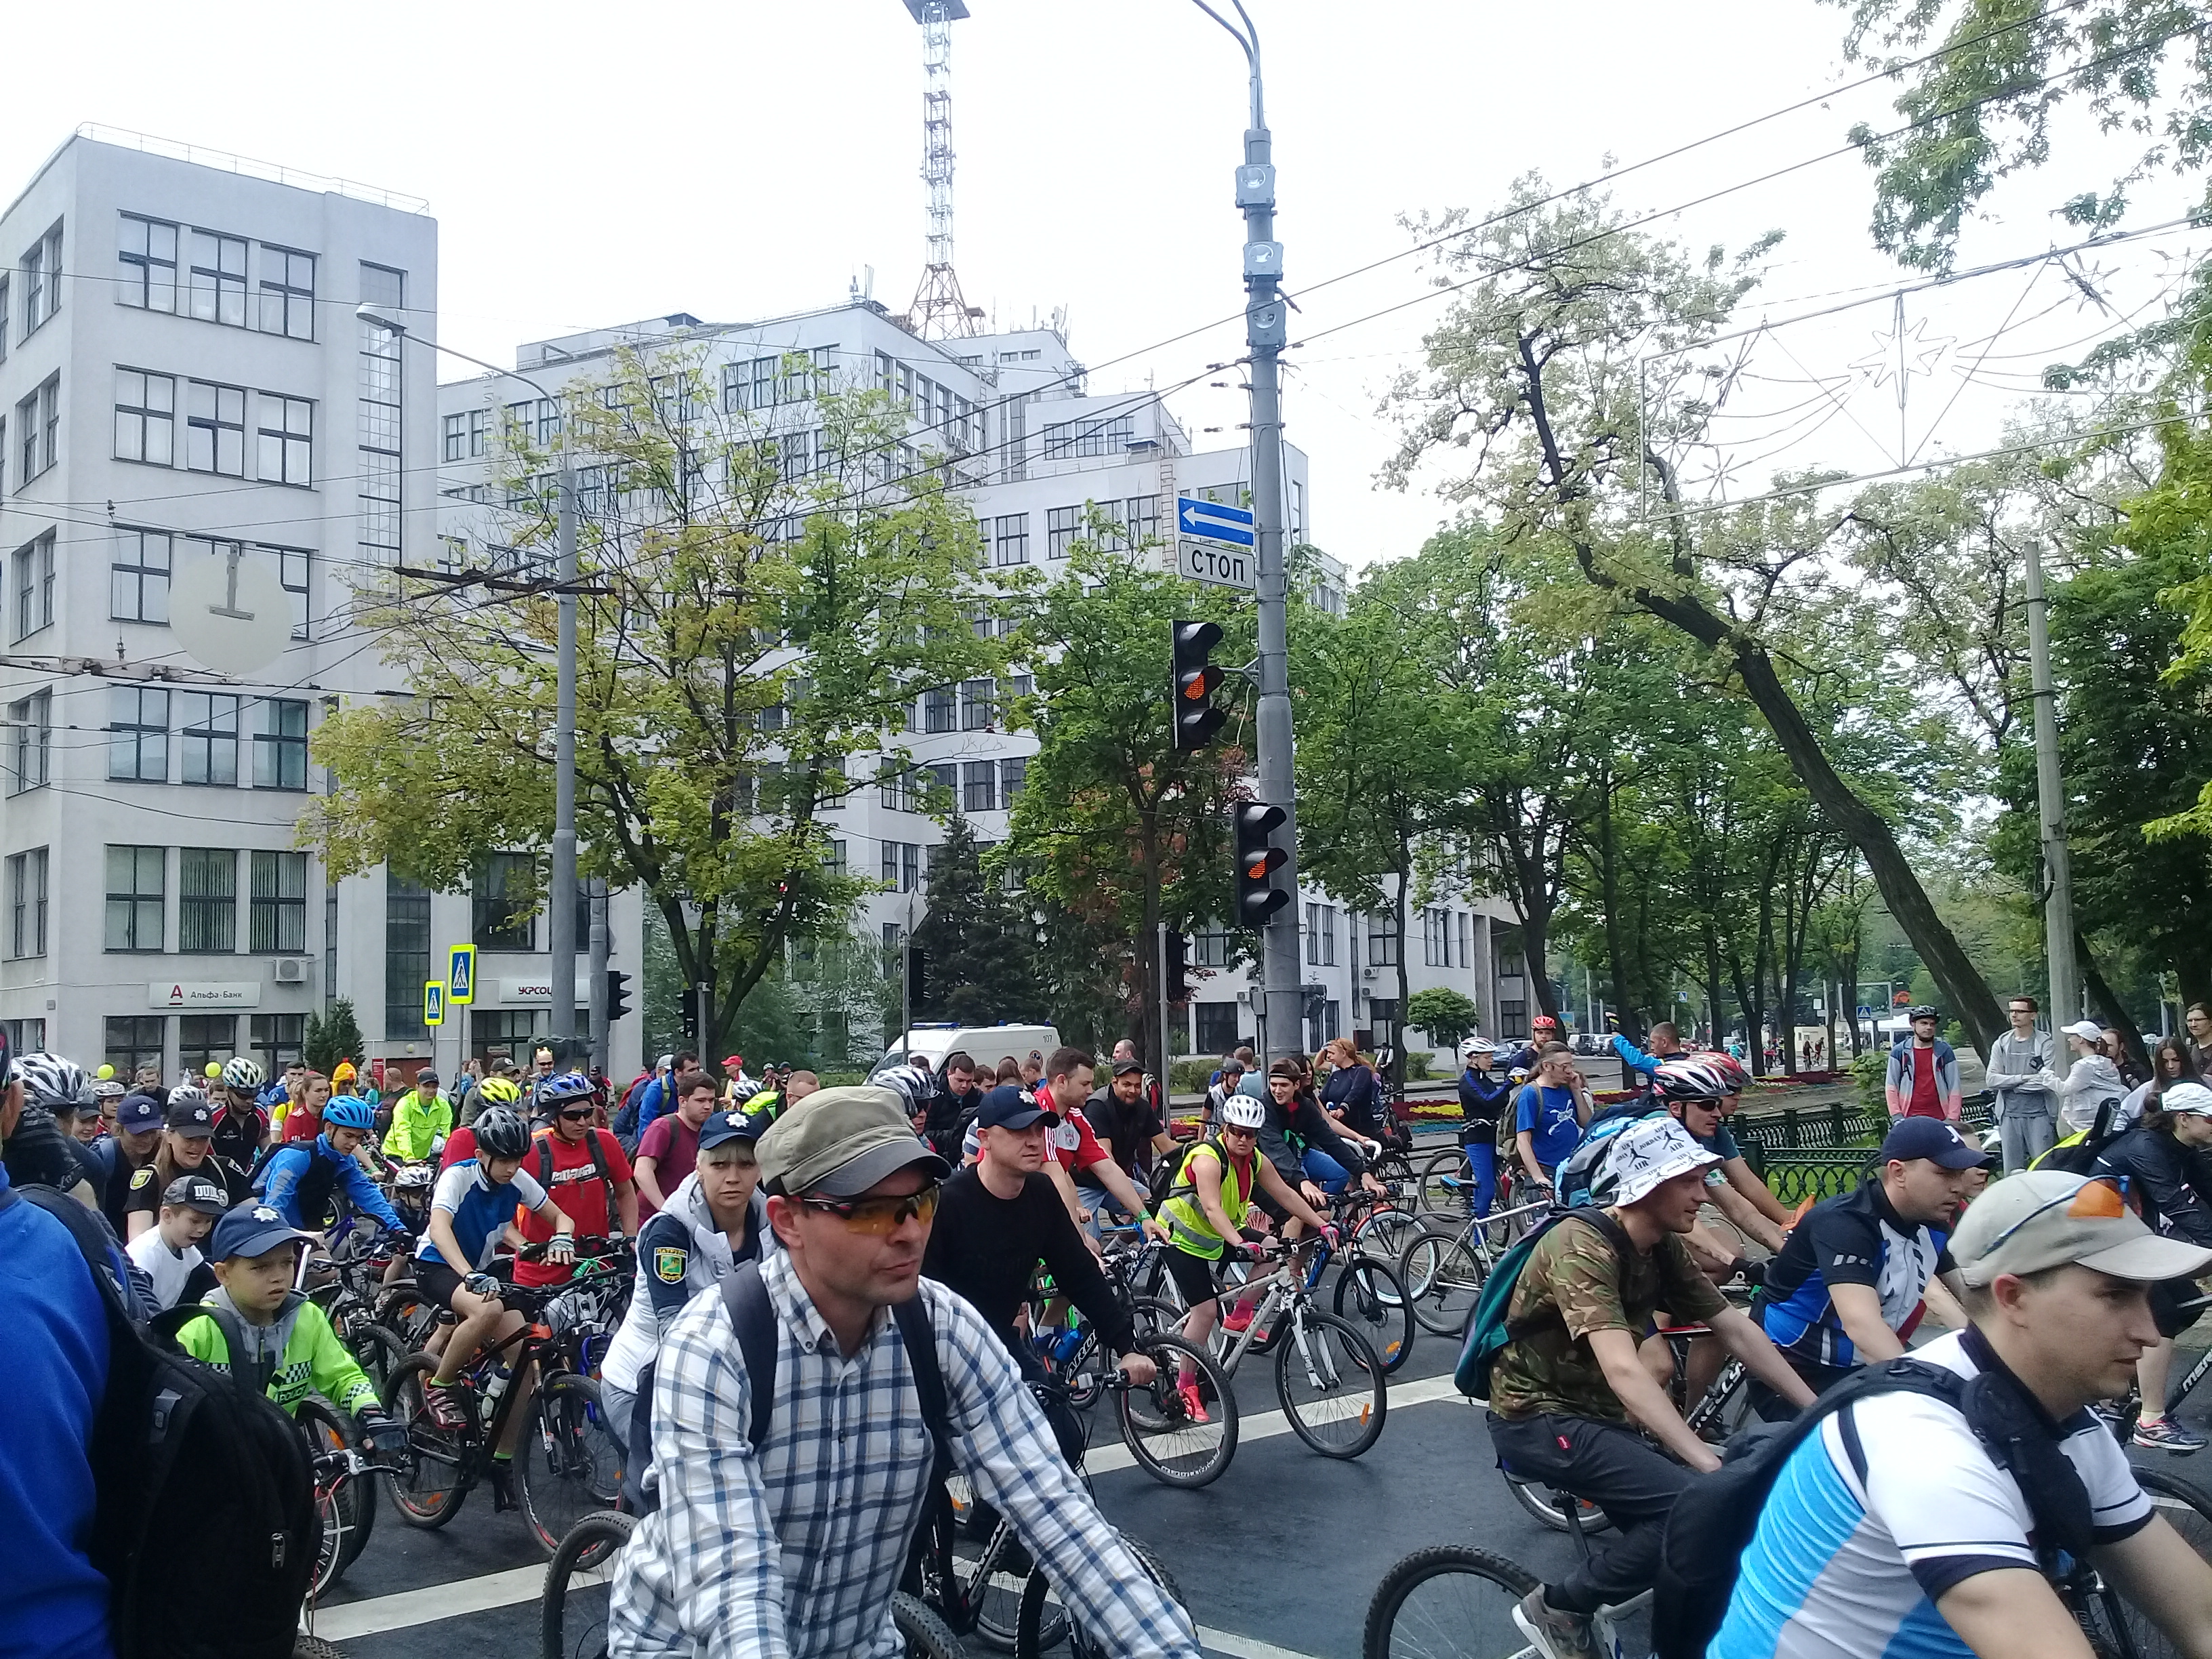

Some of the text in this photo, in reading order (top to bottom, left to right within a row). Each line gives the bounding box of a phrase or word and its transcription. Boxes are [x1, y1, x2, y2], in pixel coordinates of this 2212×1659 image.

[1191, 549, 1244, 582] СТОП
[1669, 1142, 1685, 1153] AIR
[1634, 1160, 1650, 1171] AIR
